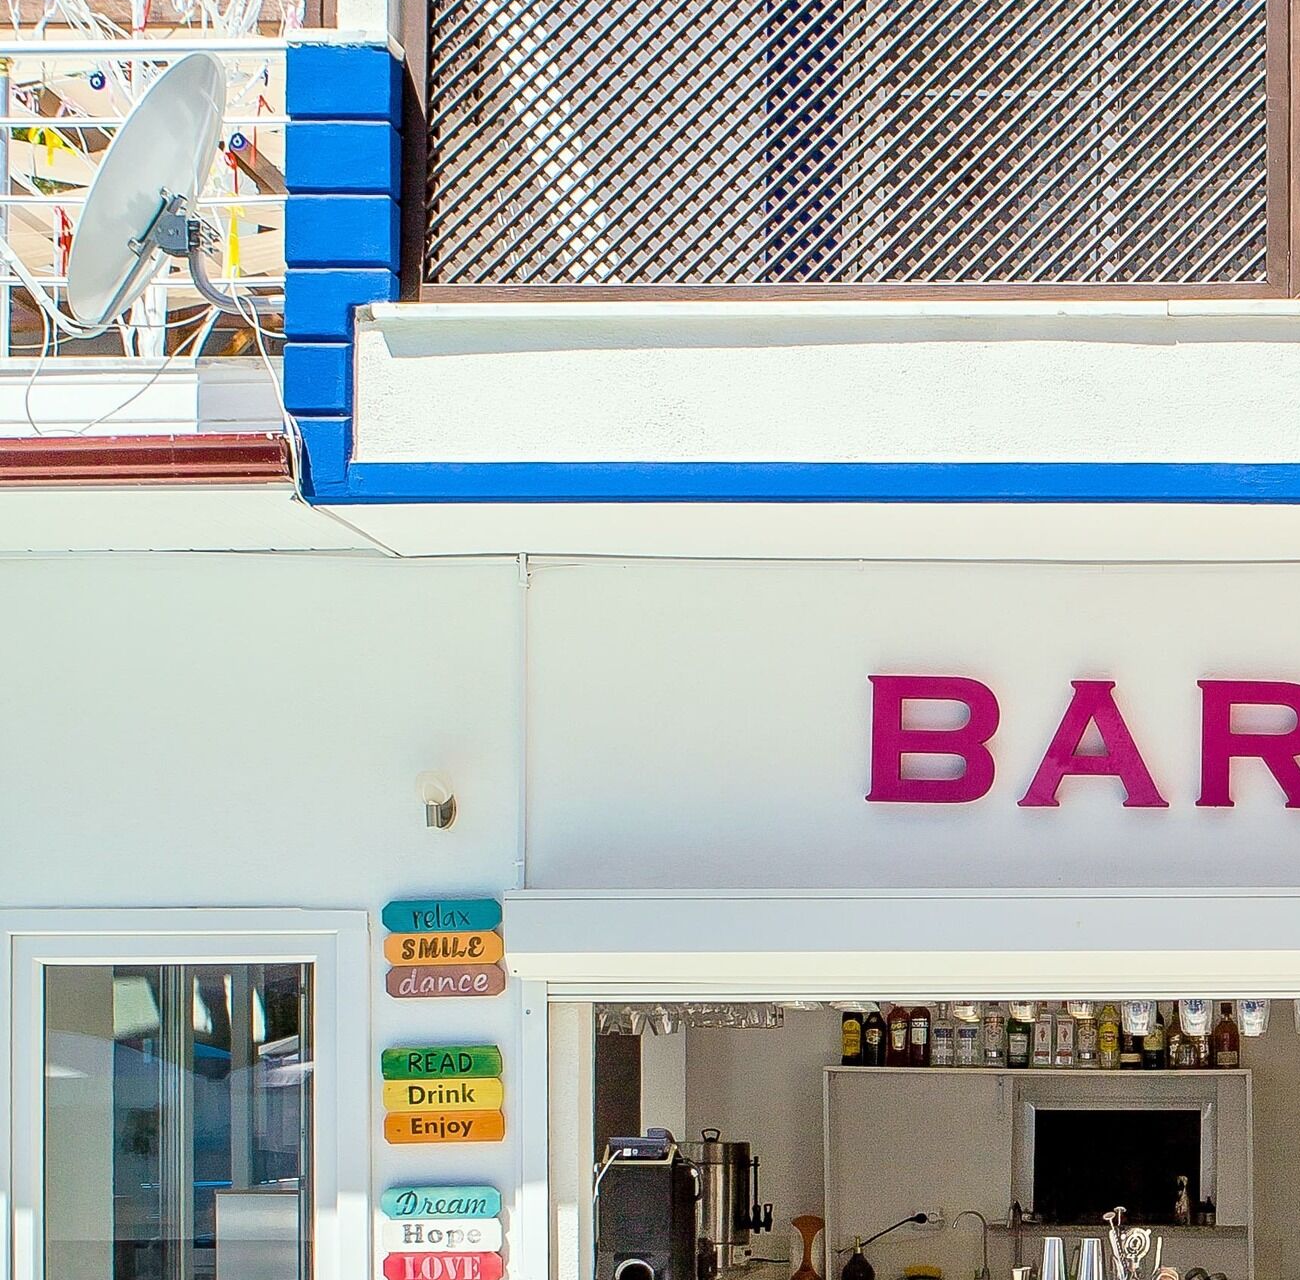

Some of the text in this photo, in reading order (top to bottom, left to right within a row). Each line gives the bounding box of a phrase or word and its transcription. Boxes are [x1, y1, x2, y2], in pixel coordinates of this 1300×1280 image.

[412, 903, 471, 929] relax
[401, 936, 485, 960] SMILE
[400, 968, 489, 995] dance
[408, 1052, 473, 1074] READ
[408, 1083, 476, 1105] Drink
[411, 1117, 473, 1139] Enjoy
[395, 1190, 487, 1216] Dream
[403, 1224, 482, 1248] Hope
[404, 1256, 481, 1280] LOVE
